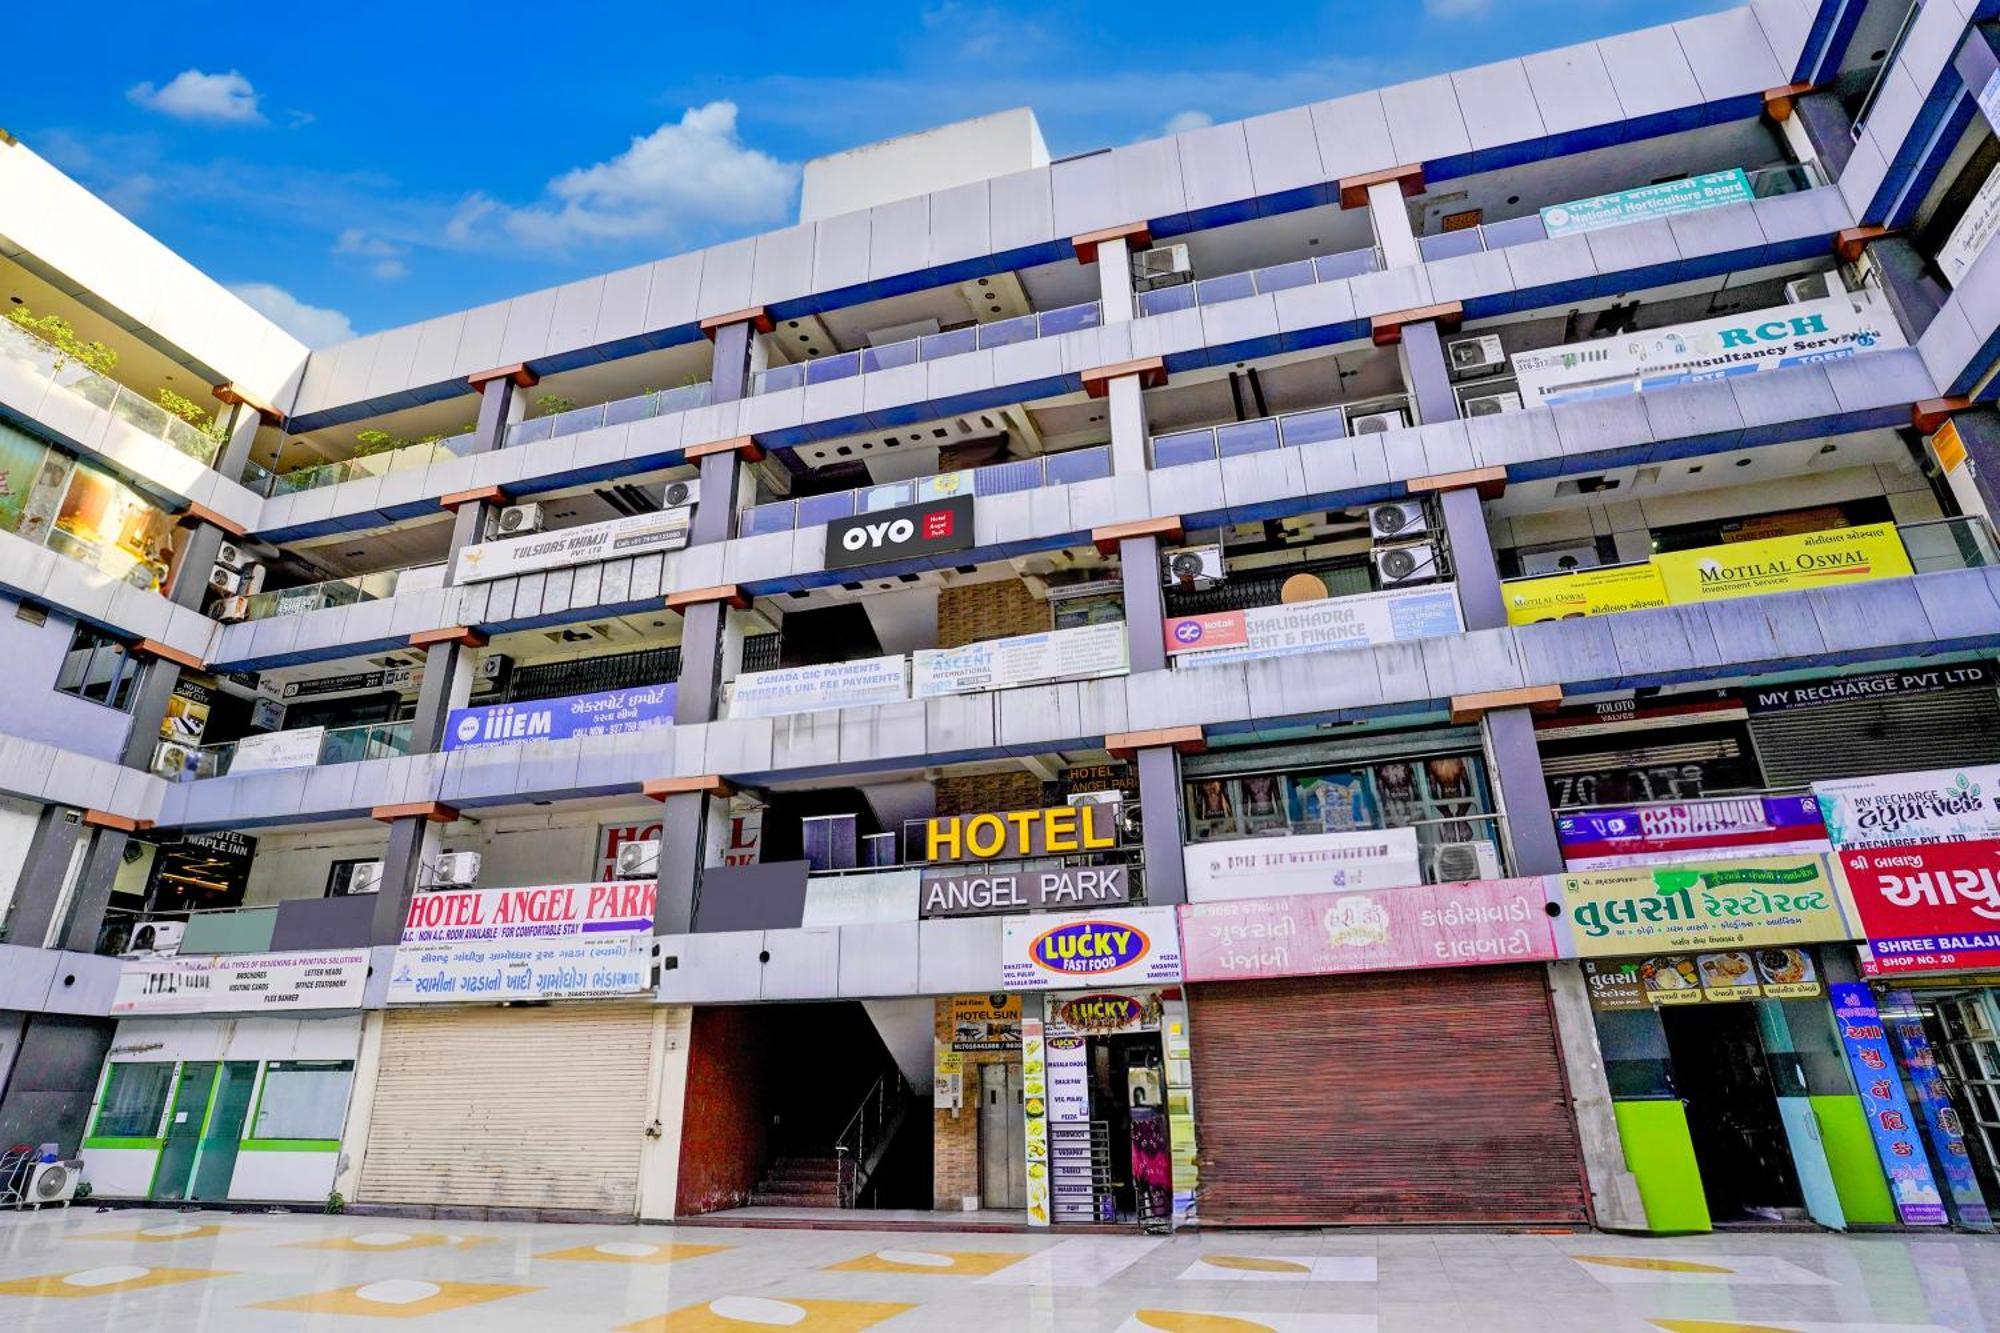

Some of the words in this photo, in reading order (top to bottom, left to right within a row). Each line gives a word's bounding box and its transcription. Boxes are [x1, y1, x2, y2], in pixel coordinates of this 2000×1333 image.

[1569, 207, 1622, 223] National
[1626, 190, 1701, 213] Horticulture
[1705, 182, 1743, 197] Board
[1718, 313, 1829, 348] RCH
[843, 519, 914, 551] OYO
[513, 539, 565, 560] TULSIDAS
[1796, 549, 1869, 571] OSWAL
[1701, 580, 1750, 594] Investment
[1752, 576, 1789, 588] Services
[1205, 617, 1235, 630] kotak
[1246, 608, 1356, 634] SHALIBHADRA
[1301, 623, 1366, 645] FINANCE
[933, 653, 993, 671] ASCENT
[757, 672, 799, 685] CANADA
[824, 662, 881, 677] PAYMENTS
[933, 664, 992, 679] INTERNATIONAL
[738, 684, 792, 699] OVERSEAS
[820, 679, 839, 690] FEE
[843, 672, 900, 687] PAYMENTS
[1758, 691, 1788, 706] MY
[1796, 677, 1898, 703] RECHARGE
[1903, 672, 1939, 689] PVT
[1947, 668, 1983, 683] LTD
[1596, 699, 1635, 714] ZOLOTO
[1600, 712, 1635, 722] VALVES
[1070, 766, 1115, 780] HOTEL
[1072, 780, 1108, 793] ANGEL
[1112, 778, 1137, 790] PAR
[1854, 798, 1872, 807] MY
[1874, 789, 1940, 807] RECHARGE
[928, 805, 1114, 861] HOTEL
[188, 834, 226, 852] MAPLE
[228, 843, 249, 857] INN
[1859, 837, 1917, 850] RECHARGE
[1850, 855, 1869, 870] શ્રી
[1874, 855, 1923, 868] બાલાજી
[926, 876, 1027, 910] ANGEL
[1040, 869, 1121, 902] PARK
[407, 892, 485, 928] HOTEL
[491, 885, 578, 924] ANGEL
[585, 883, 659, 919] PARK
[1574, 886, 1696, 937] તુલસી
[418, 930, 432, 942] NON
[445, 929, 464, 940] ROOM
[464, 927, 497, 940] AVAILABLE
[501, 926, 515, 937] FOR
[515, 924, 562, 938] COMFORTABLE
[562, 923, 580, 934] STAY
[1209, 916, 1297, 946] ગુજરાતી
[1045, 931, 1132, 960] LUCKY
[1877, 938, 1936, 953] SHREE
[231, 961, 250, 970] TYPES
[1063, 958, 1086, 971] FAST
[1089, 956, 1117, 970] FOOD
[1220, 946, 1289, 970] પંજાબી
[1882, 956, 1914, 967] SHOP
[1917, 955, 1938, 965] NO.
[1940, 954, 1955, 963] 20
[236, 971, 267, 980] BROCHURES
[304, 968, 324, 977] LETTER
[324, 968, 342, 976] HEADS
[507, 967, 533, 991] ખાદી
[1589, 970, 1638, 990] તુલસી
[229, 983, 250, 992] VISITING
[251, 983, 269, 991] CARDS
[264, 994, 278, 1003] FLEX
[955, 1010, 992, 1020] HOTEL
[993, 1010, 1018, 1020] SUN
[1071, 1001, 1129, 1018] LUCKY
[1053, 1039, 1080, 1047] LUCKY
